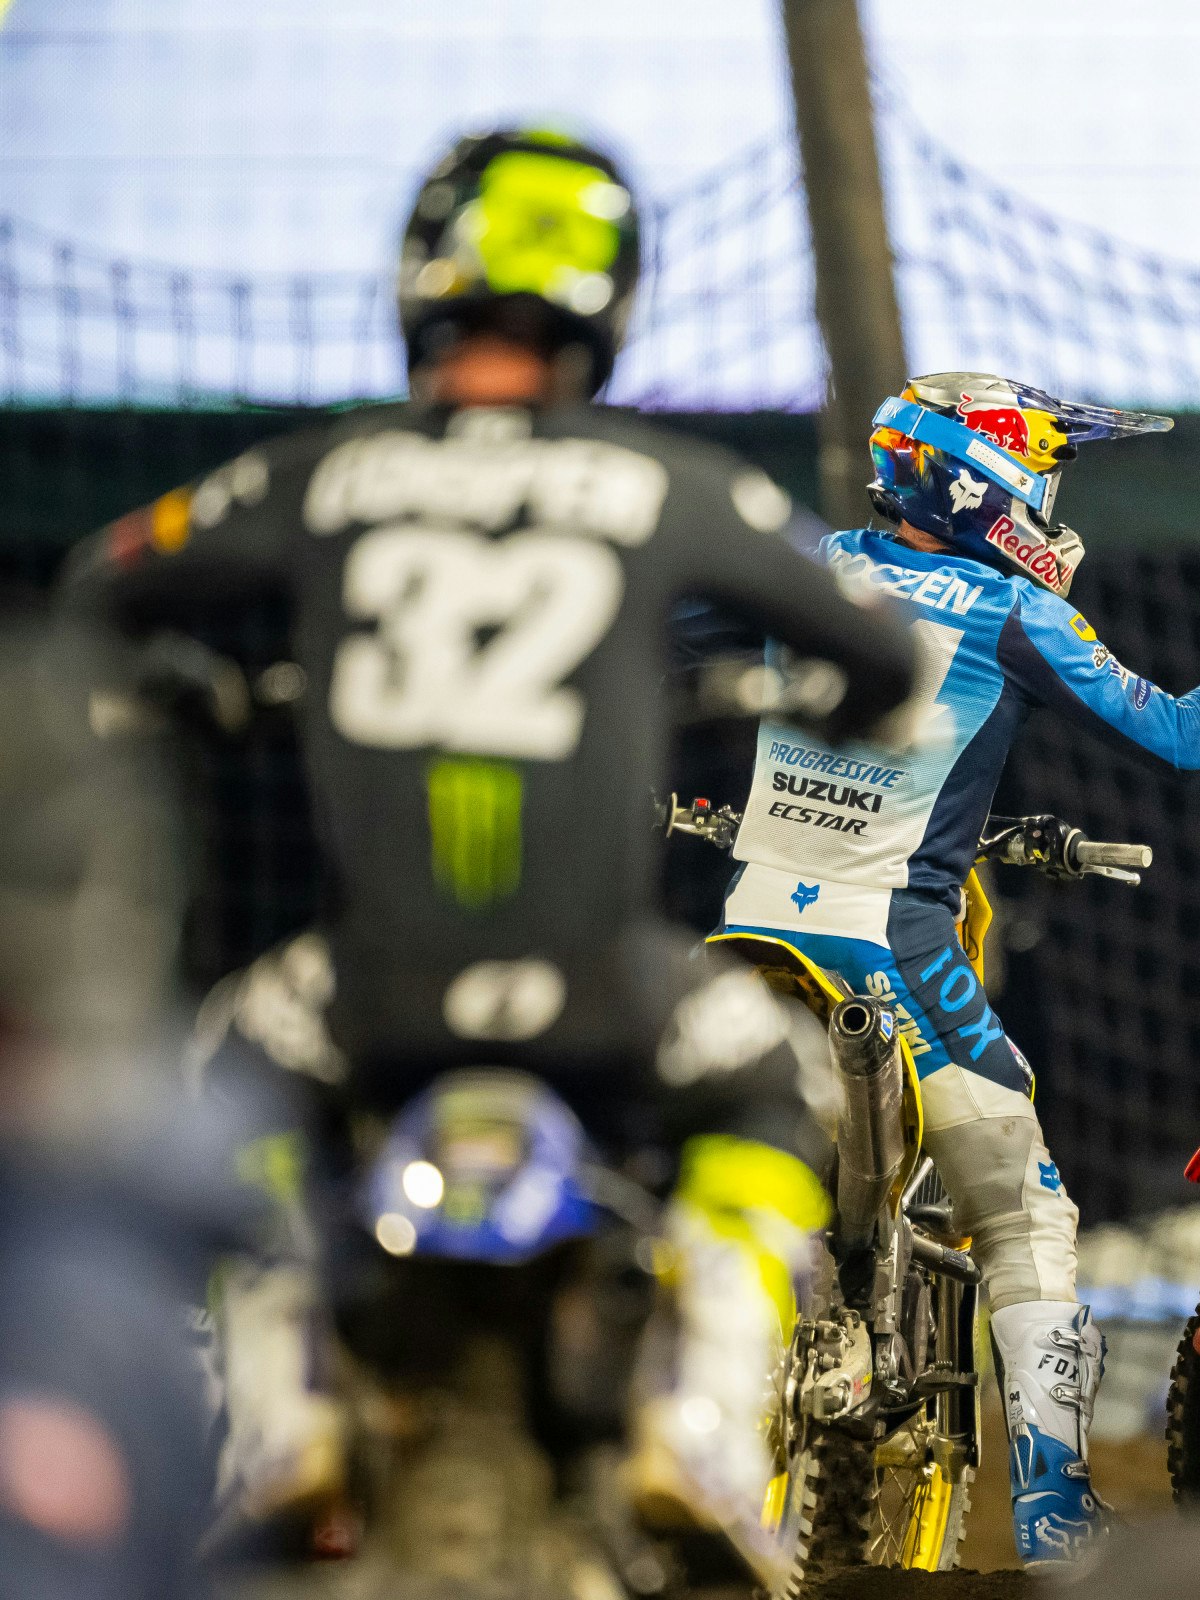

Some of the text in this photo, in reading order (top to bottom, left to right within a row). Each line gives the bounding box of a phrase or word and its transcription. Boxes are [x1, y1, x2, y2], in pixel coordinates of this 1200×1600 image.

[986, 514, 1074, 592] Red Bull
[329, 524, 625, 762] 32
[769, 740, 905, 789] PROGRESSIVE
[772, 771, 883, 814] SUZUKI
[768, 801, 869, 837] ECSTAR
[1038, 1353, 1080, 1383] FOX
